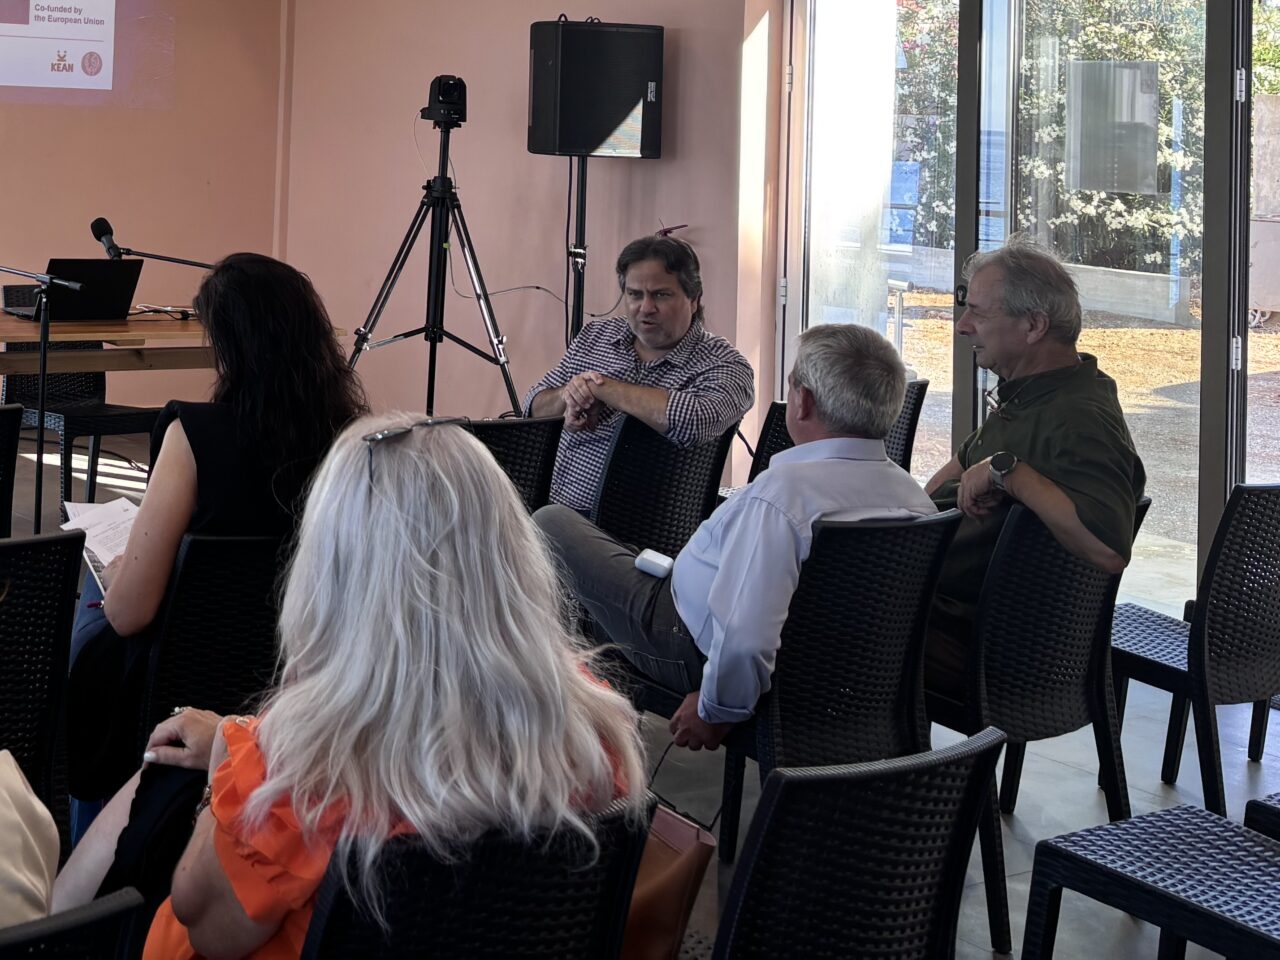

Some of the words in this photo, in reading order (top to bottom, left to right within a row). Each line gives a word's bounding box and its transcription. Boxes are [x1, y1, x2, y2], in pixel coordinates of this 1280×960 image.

[34, 3, 72, 14] Co-funded
[73, 4, 83, 16] by
[34, 14, 46, 23] the
[47, 15, 82, 25] European
[83, 17, 105, 26] Union
[50, 62, 74, 73] KEAN
